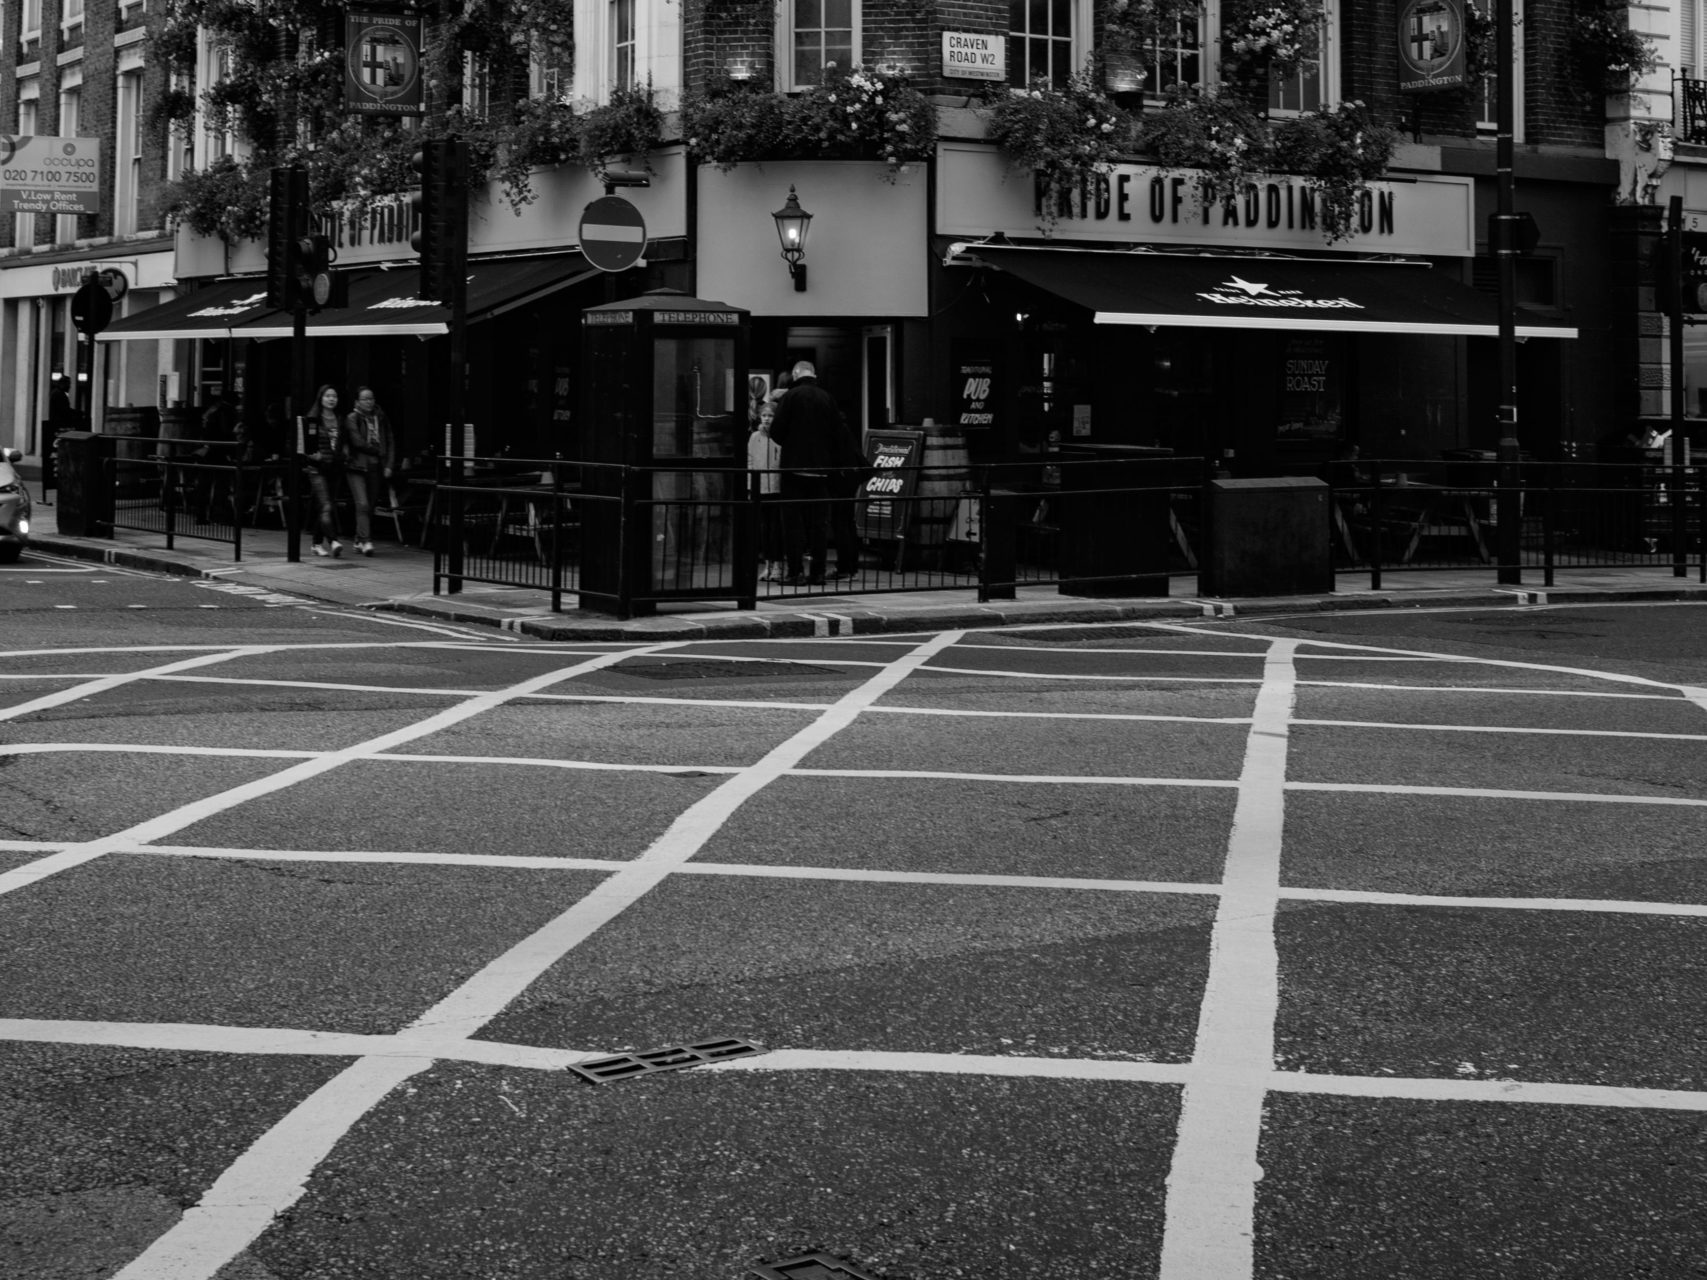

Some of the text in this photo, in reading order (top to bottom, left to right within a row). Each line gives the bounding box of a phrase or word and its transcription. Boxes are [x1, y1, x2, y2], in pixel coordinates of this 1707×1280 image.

[349, 15, 419, 27] THE PRIDE OF
[949, 36, 988, 50] CRAVEN
[949, 50, 996, 66] ROAD W2
[1400, 74, 1462, 90] PADDINGTON
[349, 101, 418, 111] PADDINGTON
[43, 157, 95, 170] occupa
[4, 169, 96, 183] 020 7100 7500
[20, 190, 78, 201] V.Low Rent
[12, 199, 85, 212] Trendy Offices
[1150, 176, 1185, 224] OF
[1200, 179, 1394, 236] PADDINON
[1692, 217, 1699, 229] 5
[1195, 293, 1366, 309] Heineken
[657, 310, 734, 324] TELEPHONE
[1286, 359, 1329, 375] SUNDAY
[962, 377, 991, 400] PUB
[1286, 375, 1327, 392] ROAST
[970, 400, 986, 410] AND
[960, 412, 995, 425] KITCHEN
[873, 455, 905, 468] FISH
[866, 476, 905, 493] CHIPS
